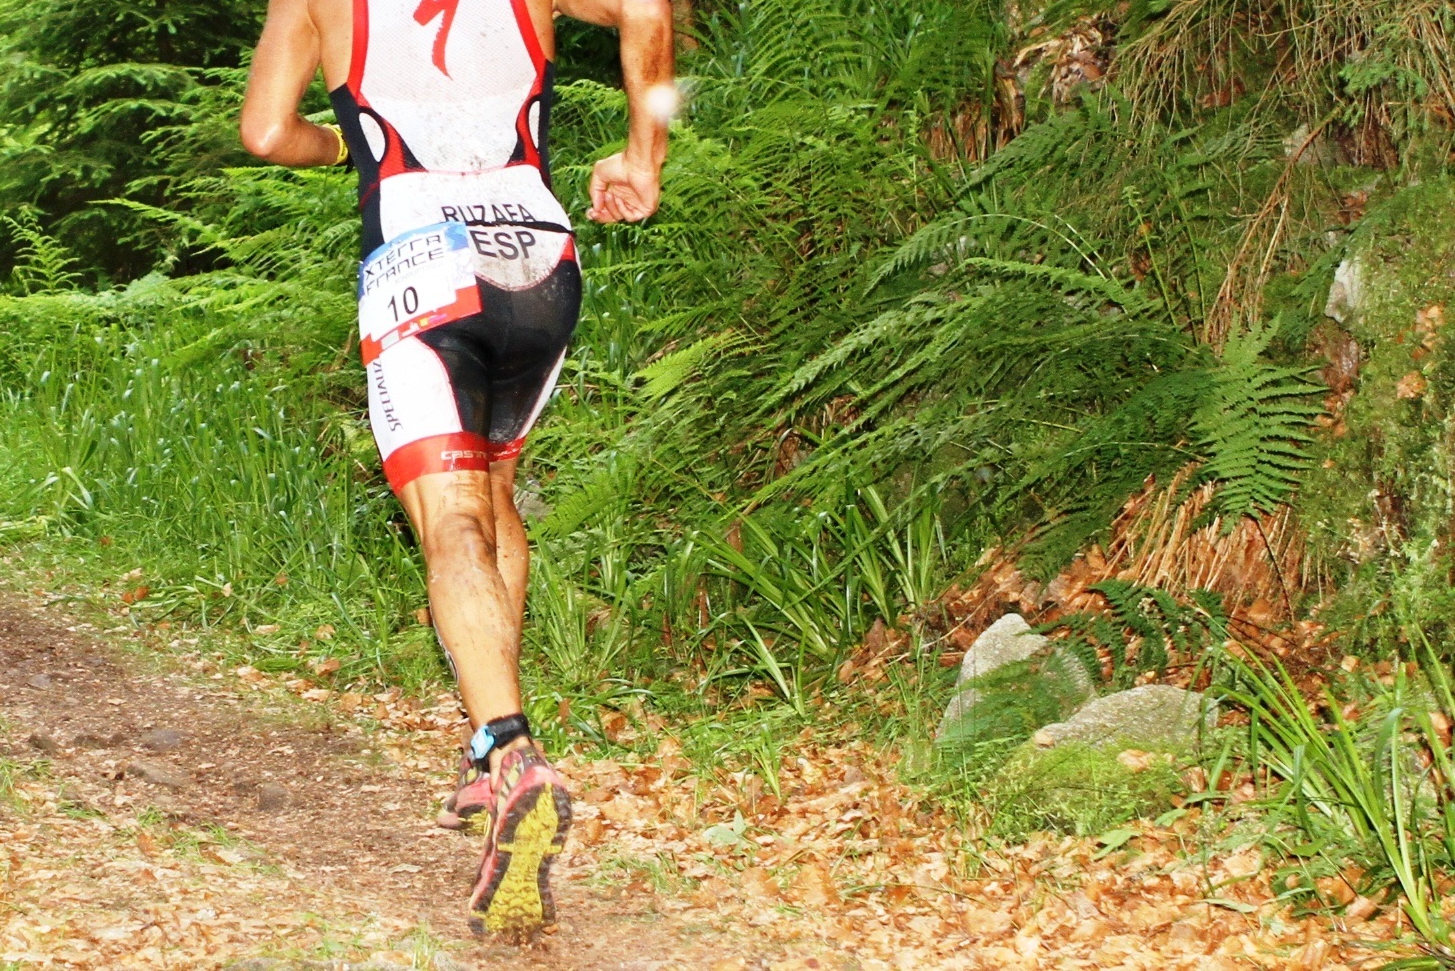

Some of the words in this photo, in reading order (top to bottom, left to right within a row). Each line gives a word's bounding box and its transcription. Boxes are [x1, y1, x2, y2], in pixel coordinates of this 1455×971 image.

[441, 203, 537, 223] RUZAFA
[365, 234, 442, 280] XTERRA
[469, 230, 536, 260] ESP
[367, 247, 444, 296] FRANCE
[387, 286, 419, 322] 10
